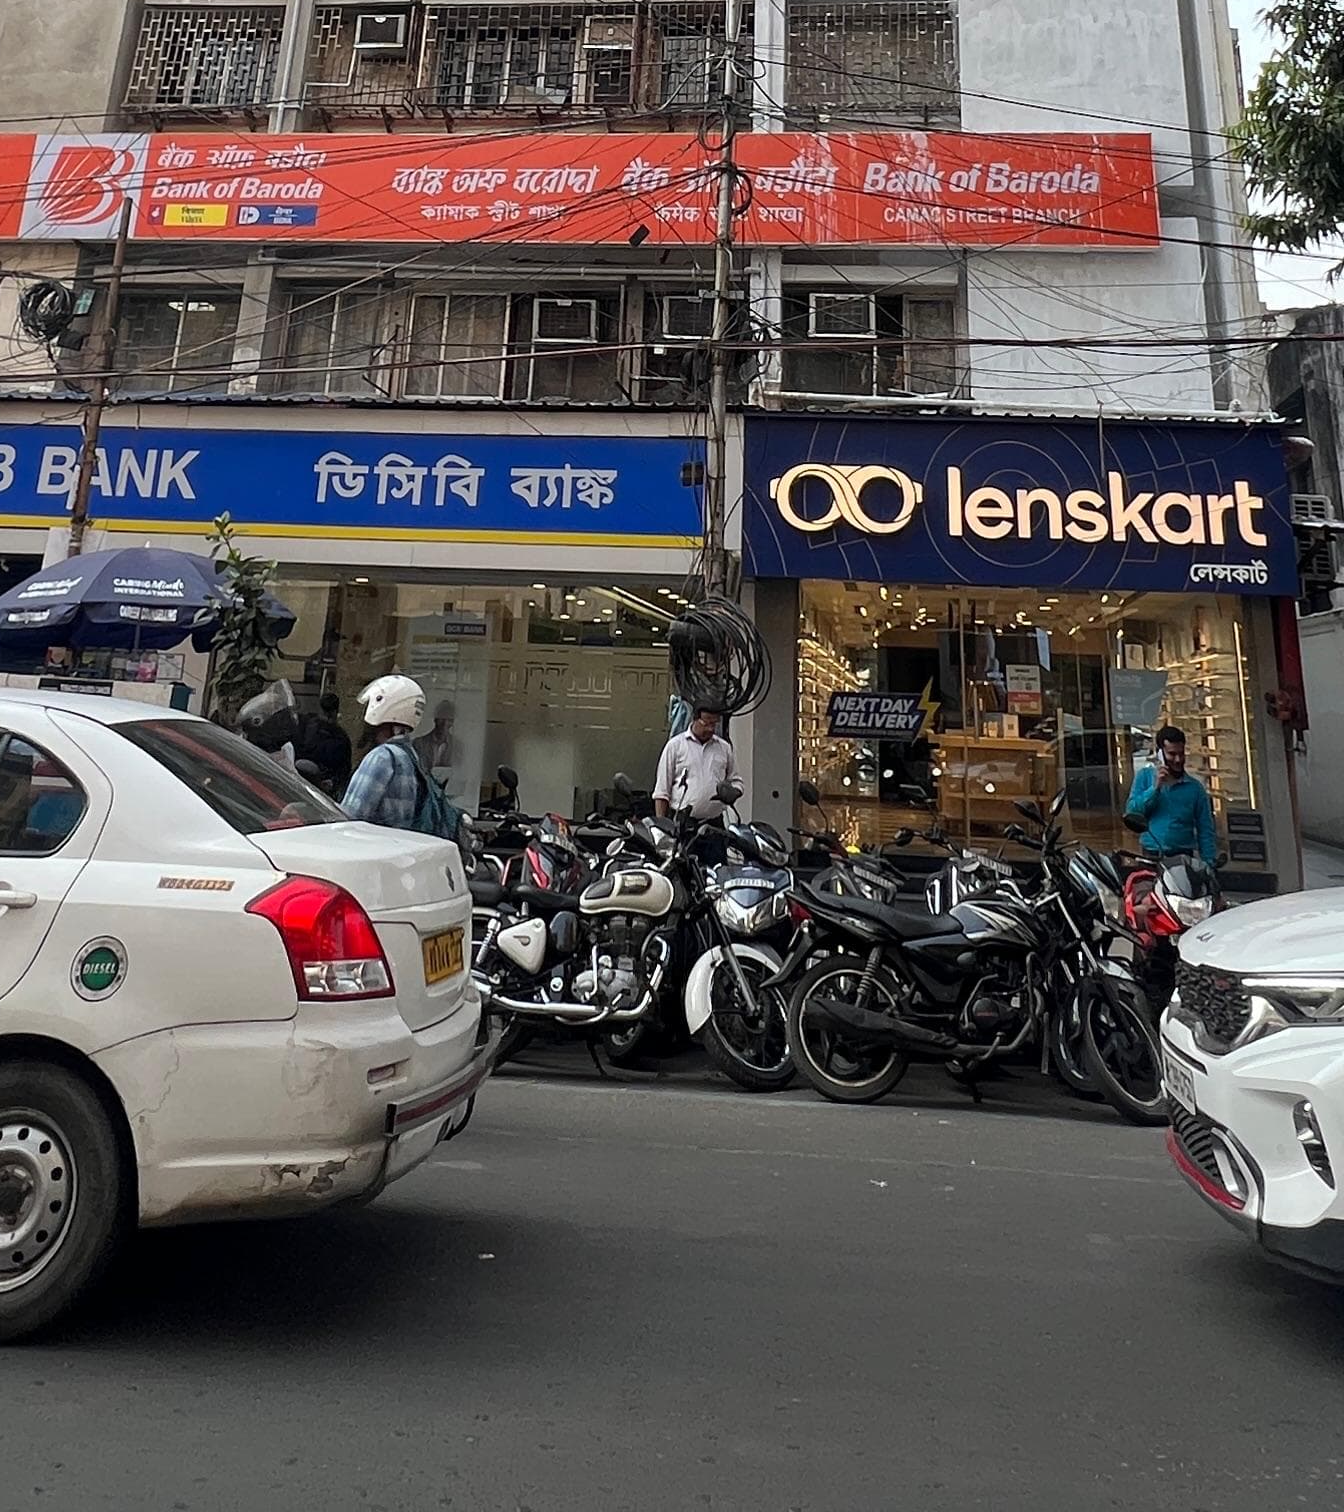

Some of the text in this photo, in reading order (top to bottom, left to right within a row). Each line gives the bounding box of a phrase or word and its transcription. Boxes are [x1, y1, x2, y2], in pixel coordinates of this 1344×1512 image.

[151, 176, 325, 199] Bank of Baroda
[452, 167, 508, 194] অফ
[512, 164, 600, 195] বরোদা
[862, 161, 1101, 195] Bank of Baroda
[884, 206, 1082, 225] CAMAC STREET BRANCH
[36, 445, 201, 500] BANK
[946, 465, 1268, 547] lenskart
[832, 696, 915, 714] NEXT DAY
[835, 711, 921, 729] DELIVERY
[82, 963, 116, 975] DIESEL
